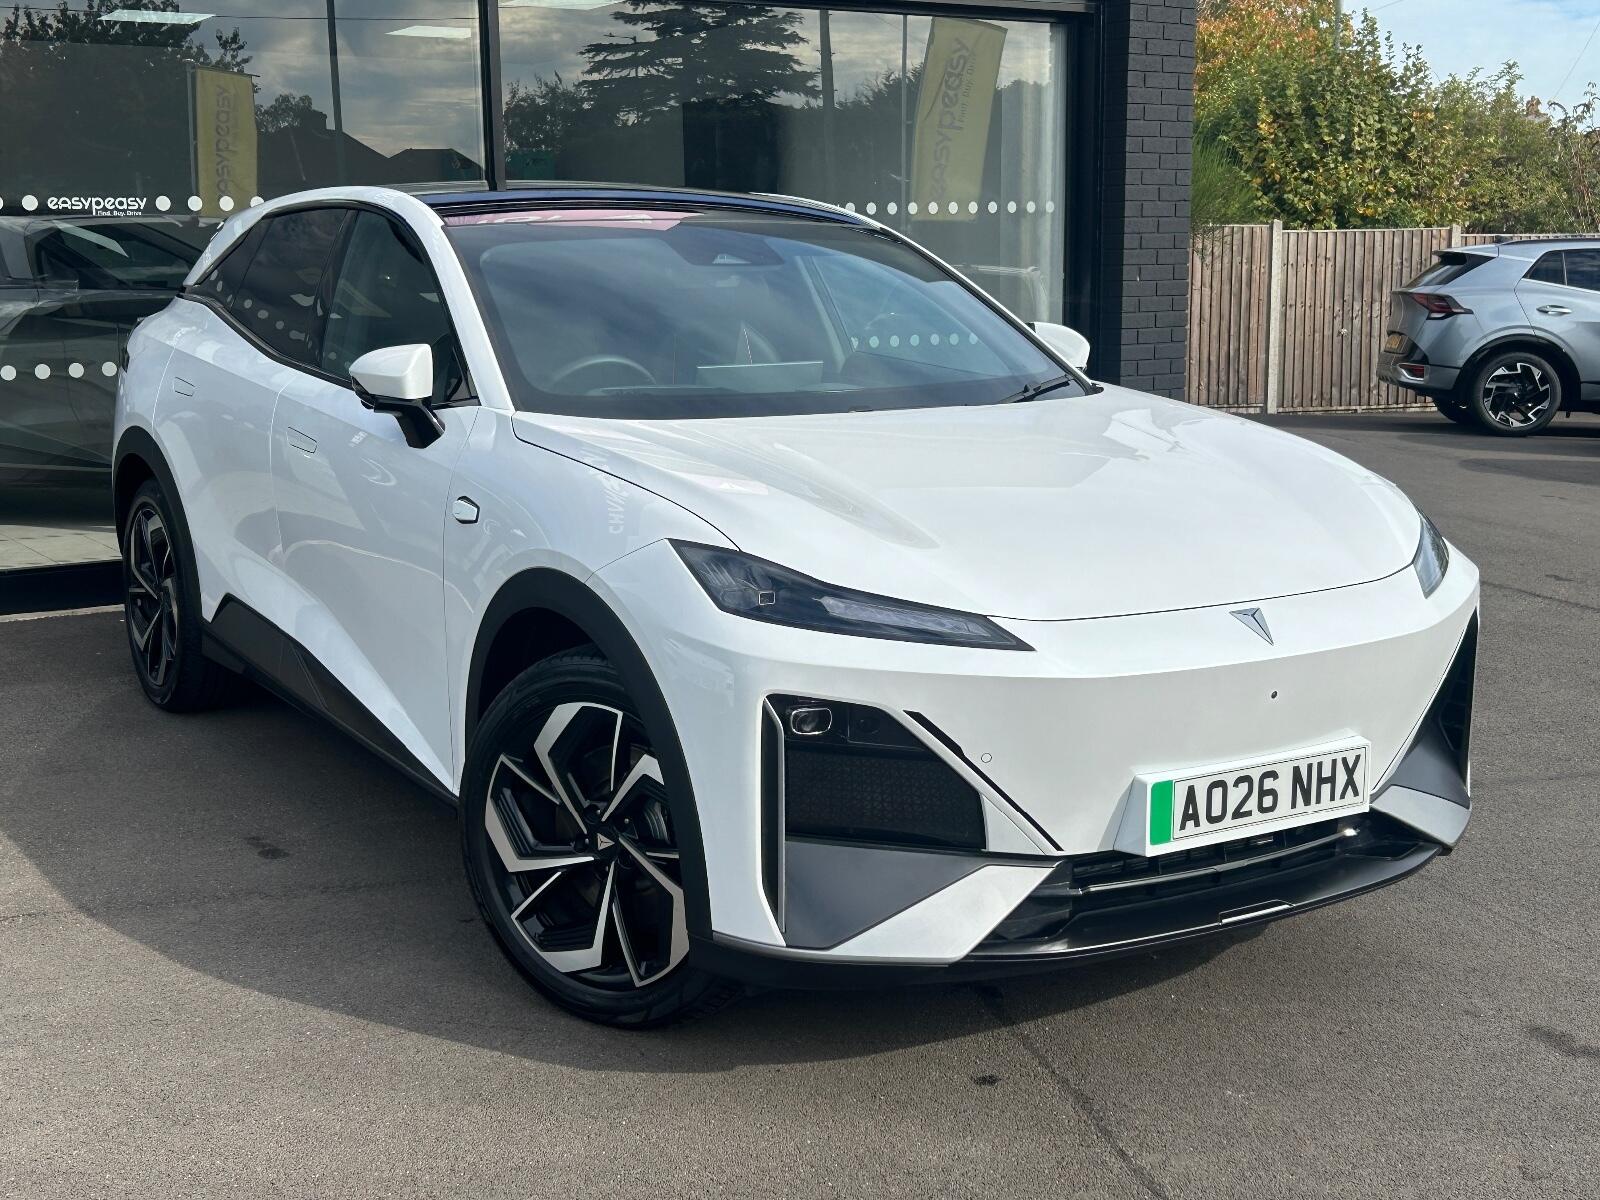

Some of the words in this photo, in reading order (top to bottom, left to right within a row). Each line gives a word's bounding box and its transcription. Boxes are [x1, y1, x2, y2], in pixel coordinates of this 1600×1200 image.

[215, 84, 238, 198] asypeasy
[1178, 768, 1280, 832] AO26
[1290, 753, 1362, 810] NHX
